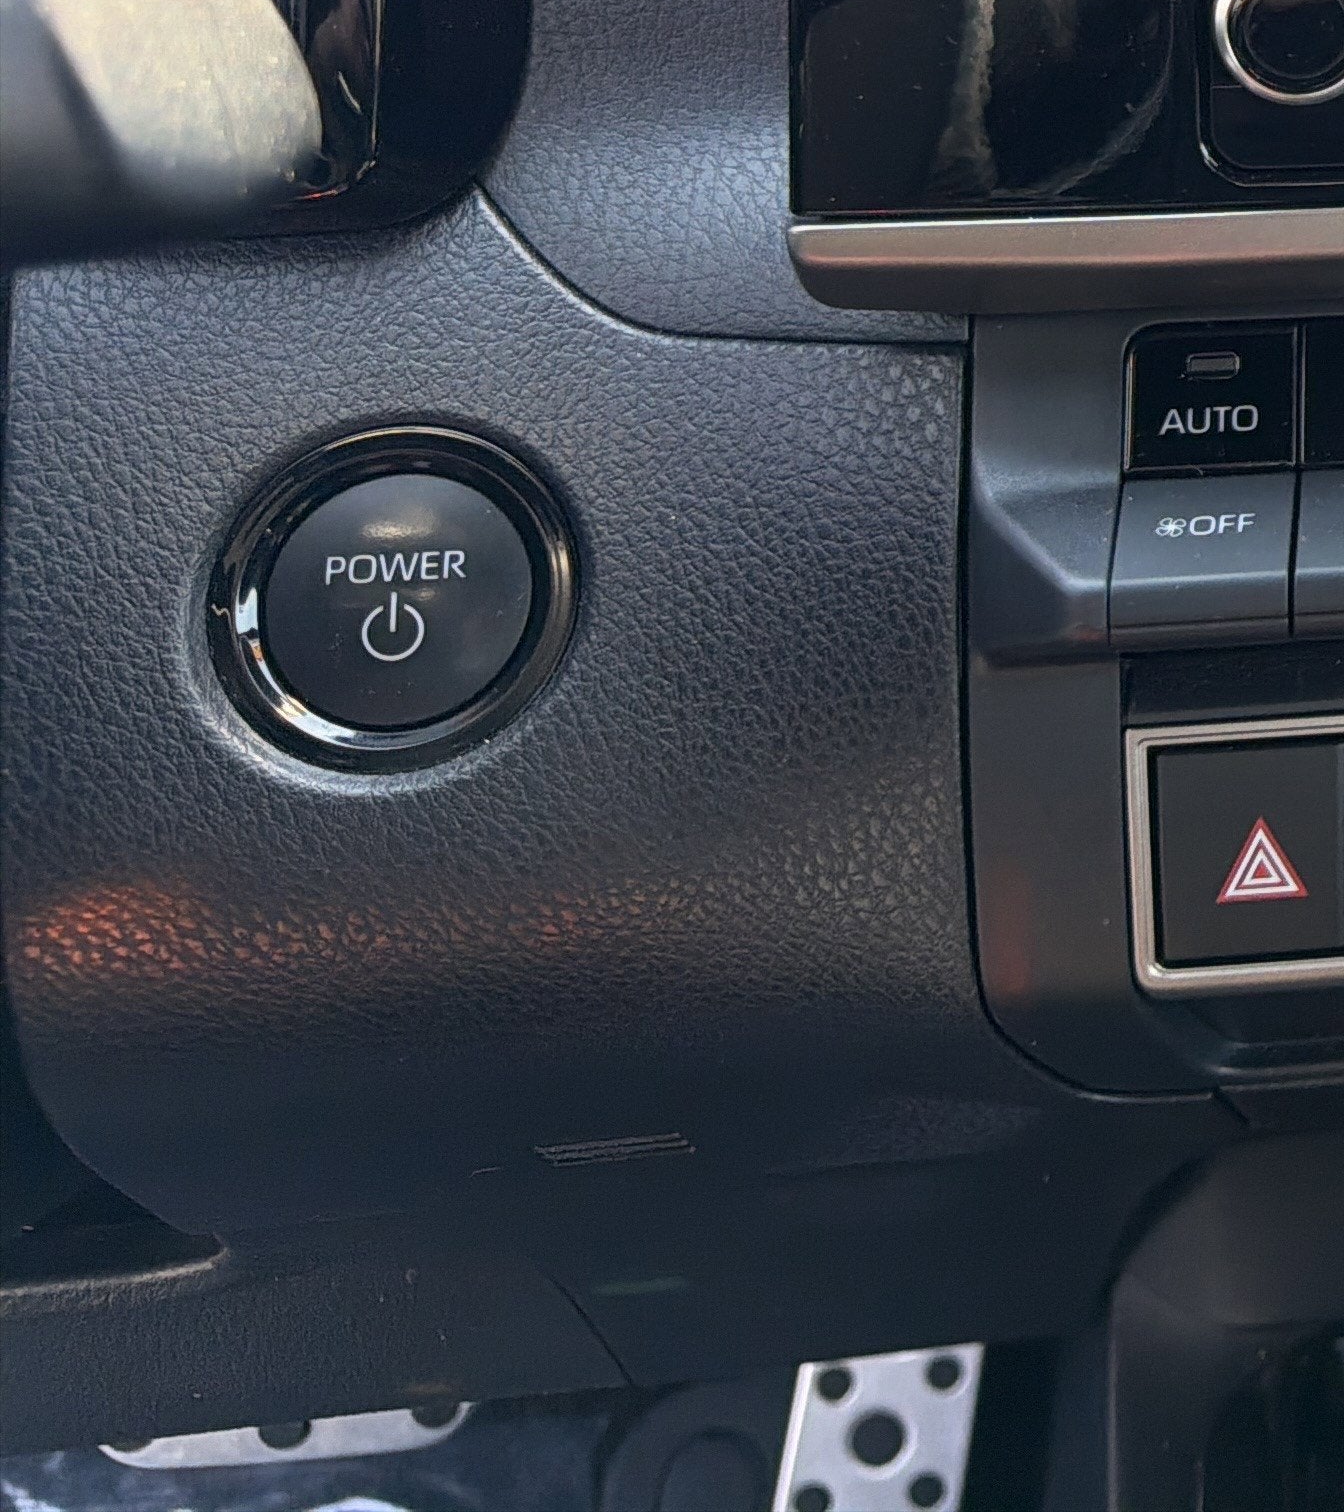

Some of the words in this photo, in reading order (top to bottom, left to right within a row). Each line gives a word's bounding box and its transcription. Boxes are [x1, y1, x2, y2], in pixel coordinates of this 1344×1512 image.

[1158, 404, 1260, 436] AUTO
[1189, 512, 1256, 538] OFF
[325, 549, 467, 587] POWER
